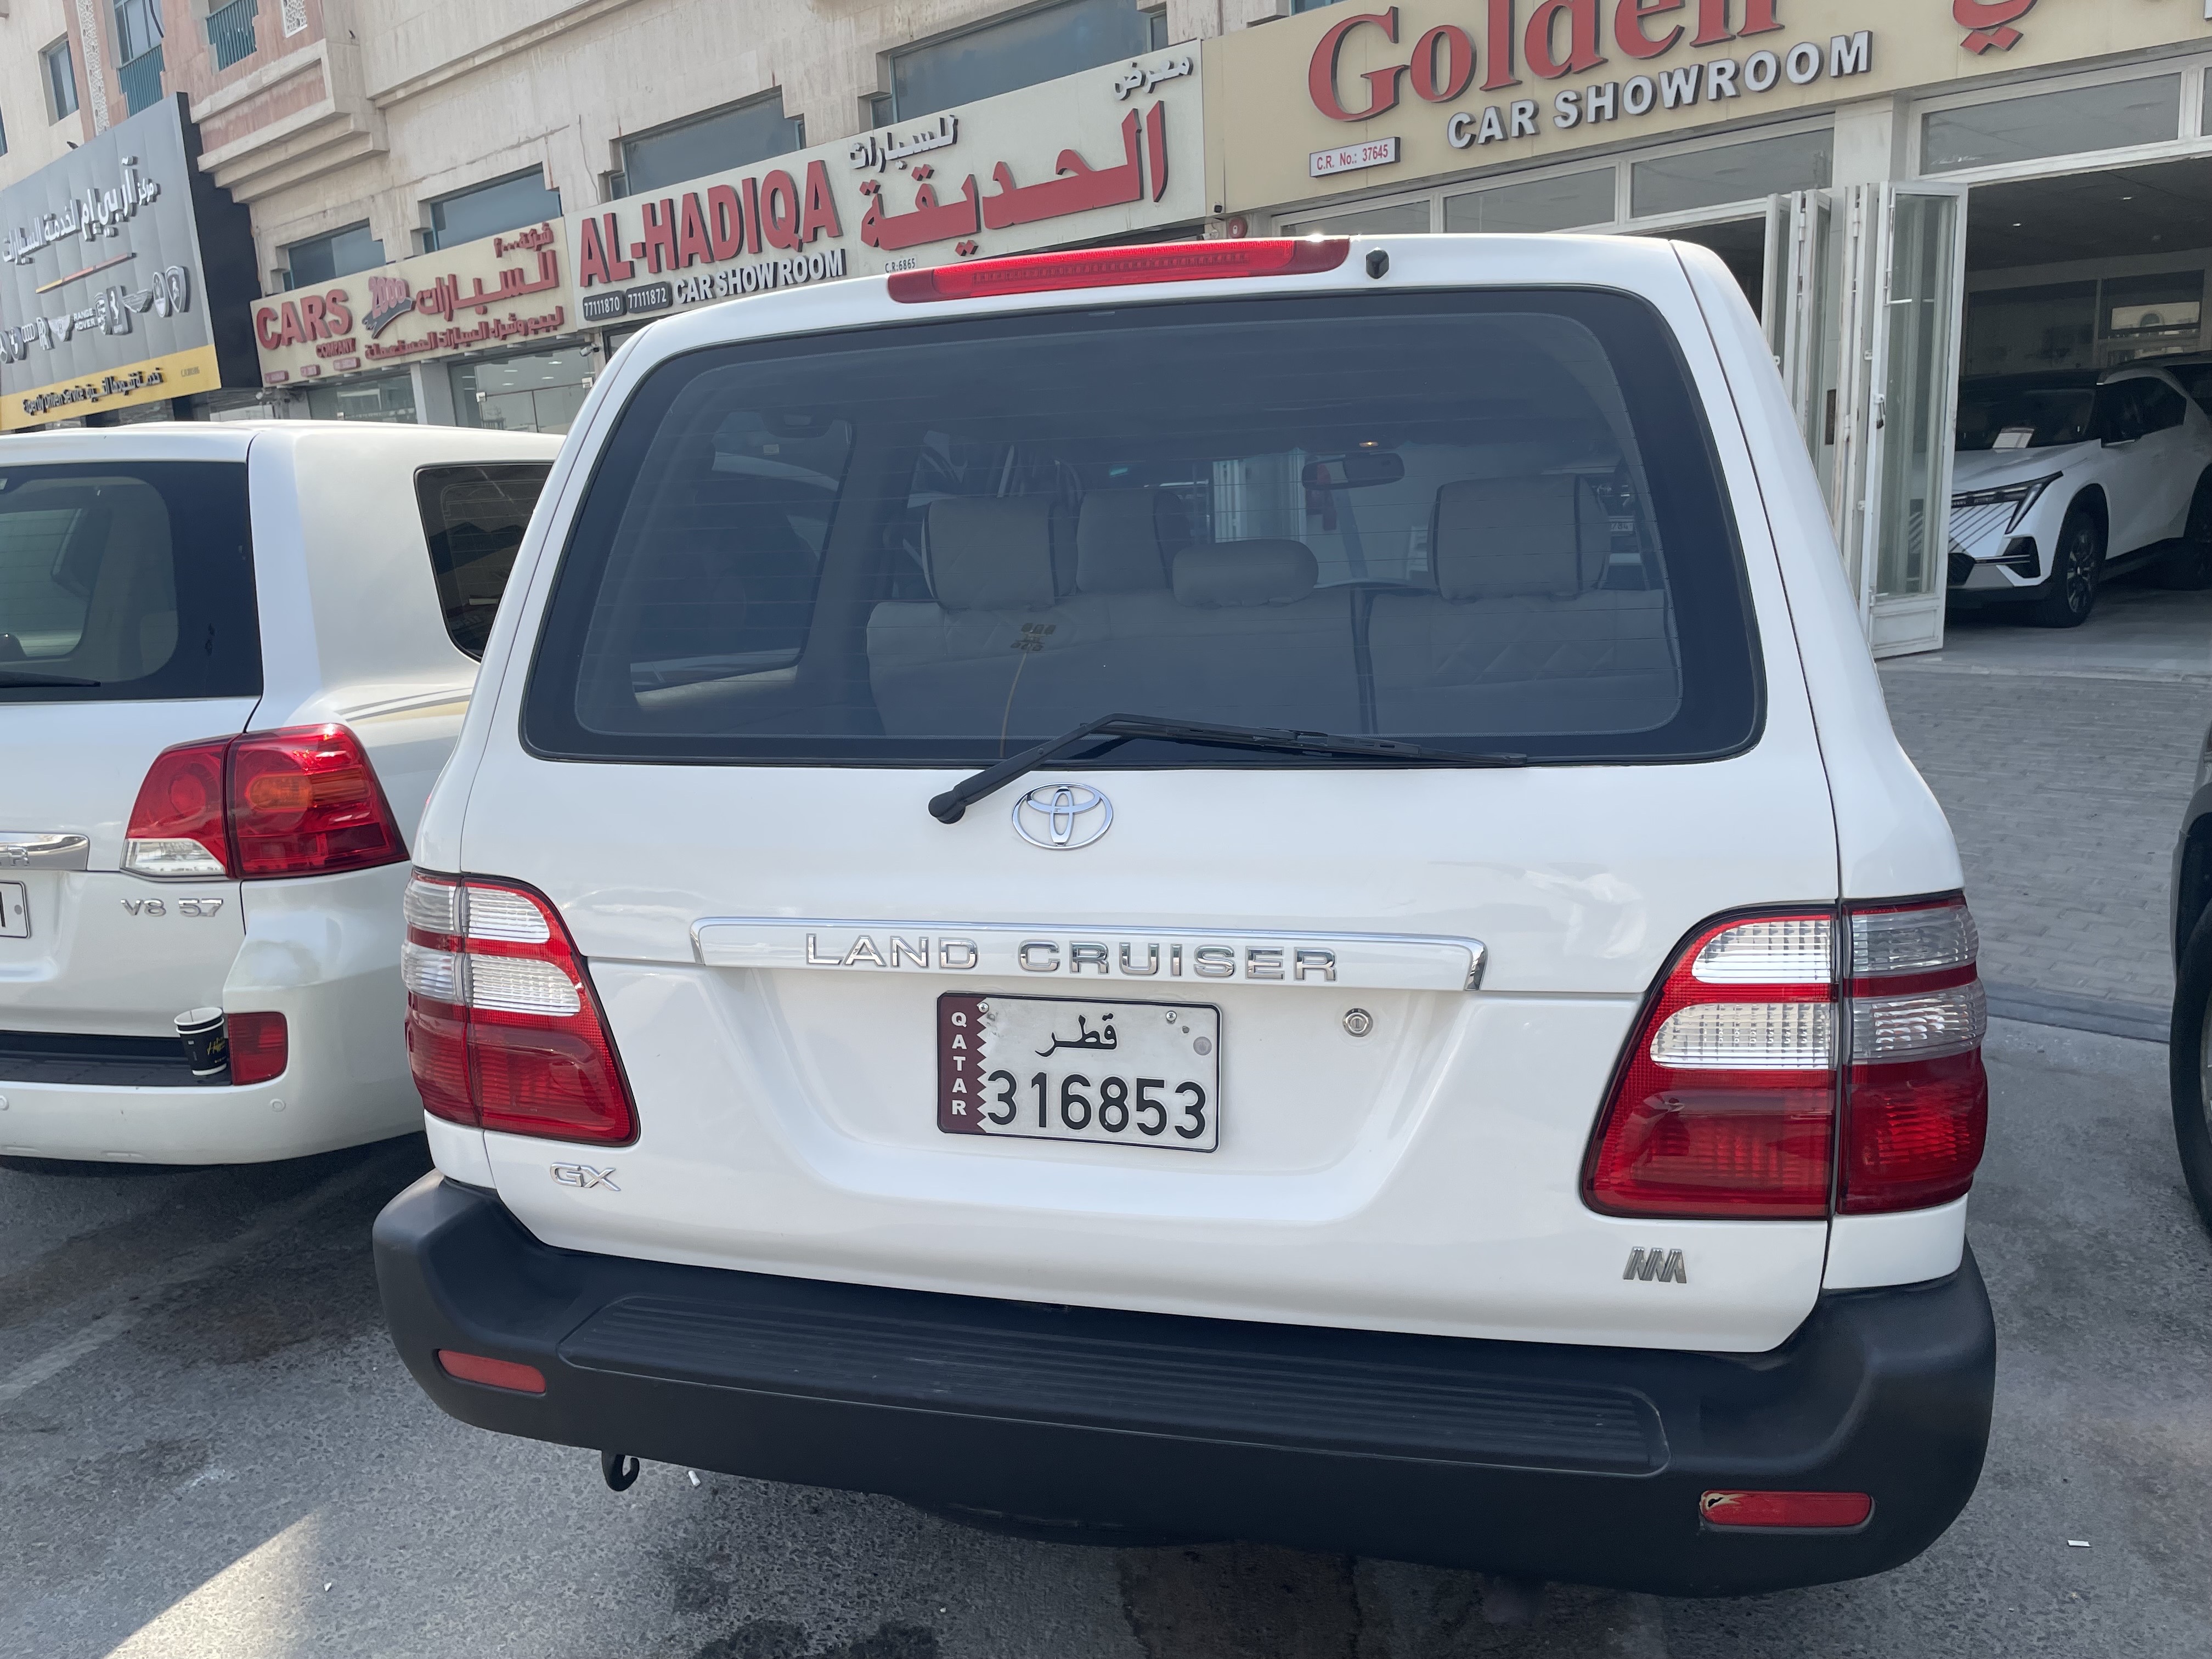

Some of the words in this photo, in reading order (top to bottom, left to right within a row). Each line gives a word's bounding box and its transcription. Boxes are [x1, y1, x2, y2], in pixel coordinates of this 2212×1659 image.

[1114, 56, 1193, 101] معرض
[1447, 99, 1539, 149] CAR
[1553, 30, 1872, 129] SHOWROOM
[849, 115, 958, 173] للسيارات
[1317, 155, 1334, 170] C.R.
[1362, 144, 1388, 162] 37645
[137, 178, 160, 206] مركز
[859, 100, 1168, 257] الحديقة
[3, 216, 46, 264] السيارات
[519, 222, 554, 252] شركة
[580, 160, 843, 287] AL-HADIQA
[416, 250, 560, 321] للسيارات
[673, 274, 715, 304] CAR
[715, 249, 846, 297] SHOWROOM
[885, 258, 915, 273] C.R:6865
[74, 308, 96, 321] RANGE
[75, 317, 99, 331] ROVER
[256, 289, 353, 350] CARS
[584, 296, 620, 317] 77111870
[628, 287, 667, 309] 77111872
[316, 337, 356, 358] COMPANY
[120, 898, 167, 917] V8
[805, 933, 979, 970] LAND
[1017, 939, 1338, 982] CRUISER
[1034, 1013, 1118, 1057] قطر
[951, 1011, 968, 1116] QATAR
[987, 1069, 1206, 1140] 316853
[549, 1161, 622, 1192] GX
